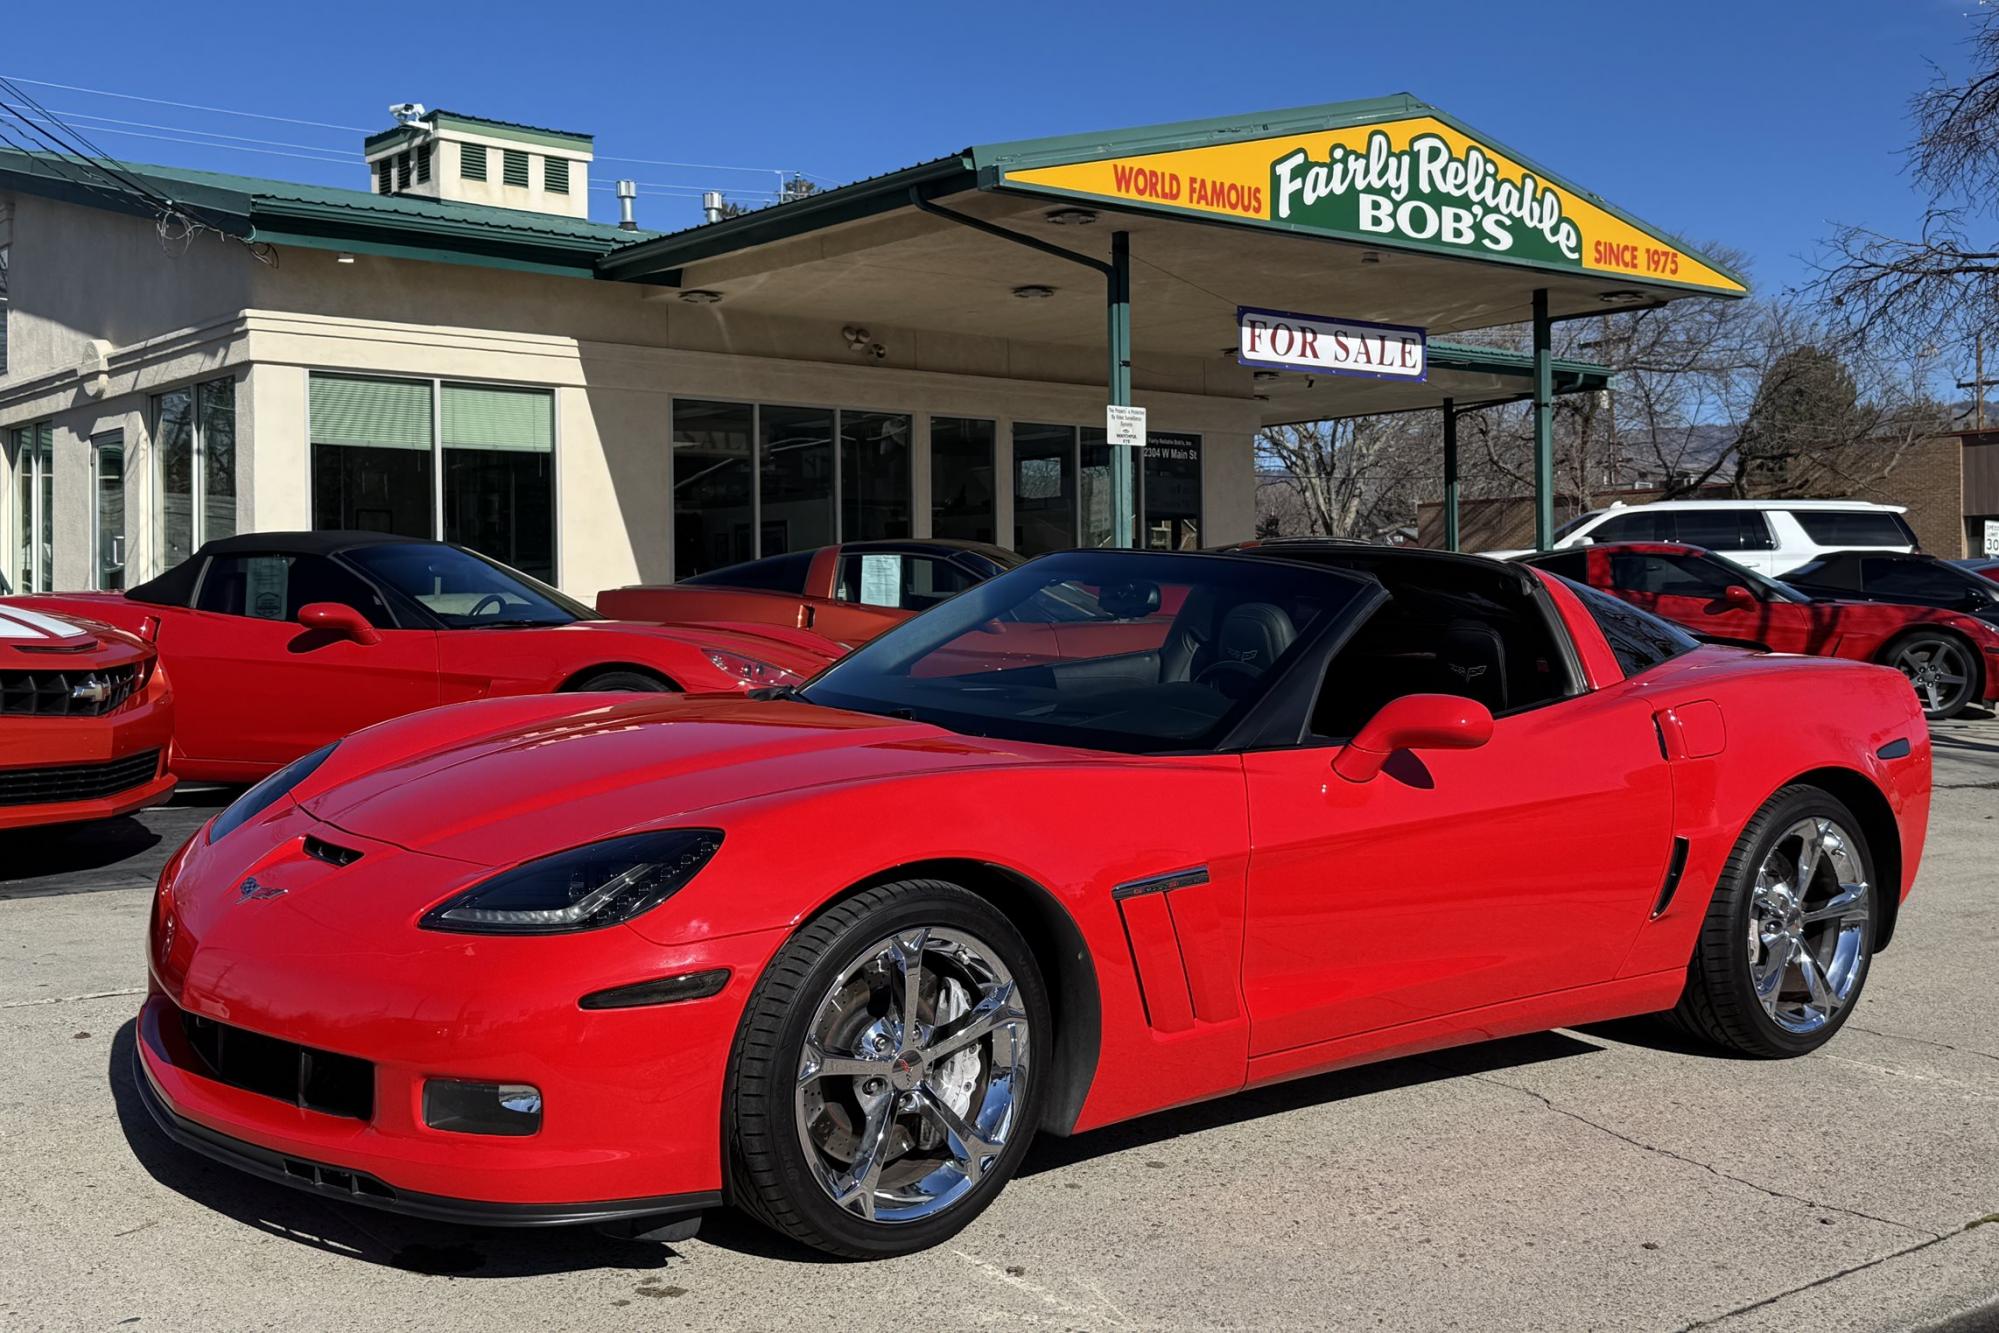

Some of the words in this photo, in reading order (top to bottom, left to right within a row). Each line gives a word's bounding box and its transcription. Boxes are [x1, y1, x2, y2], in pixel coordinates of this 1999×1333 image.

[1113, 163, 1181, 201] WORLD
[1189, 176, 1262, 214] FAMOUS
[1275, 134, 1410, 219] Fairly
[1413, 136, 1580, 260] Reliable
[1359, 193, 1513, 251] BOB'S
[1594, 239, 1638, 269] SINCE
[1645, 247, 1679, 275] 1975
[1248, 319, 1320, 360] FOR
[1334, 330, 1417, 369] SALE
[1143, 447, 1160, 458] 2304
[1161, 448, 1170, 459] W
[1170, 448, 1188, 459] Main
[1189, 449, 1198, 460] St
[1986, 538, 1999, 551] 30
